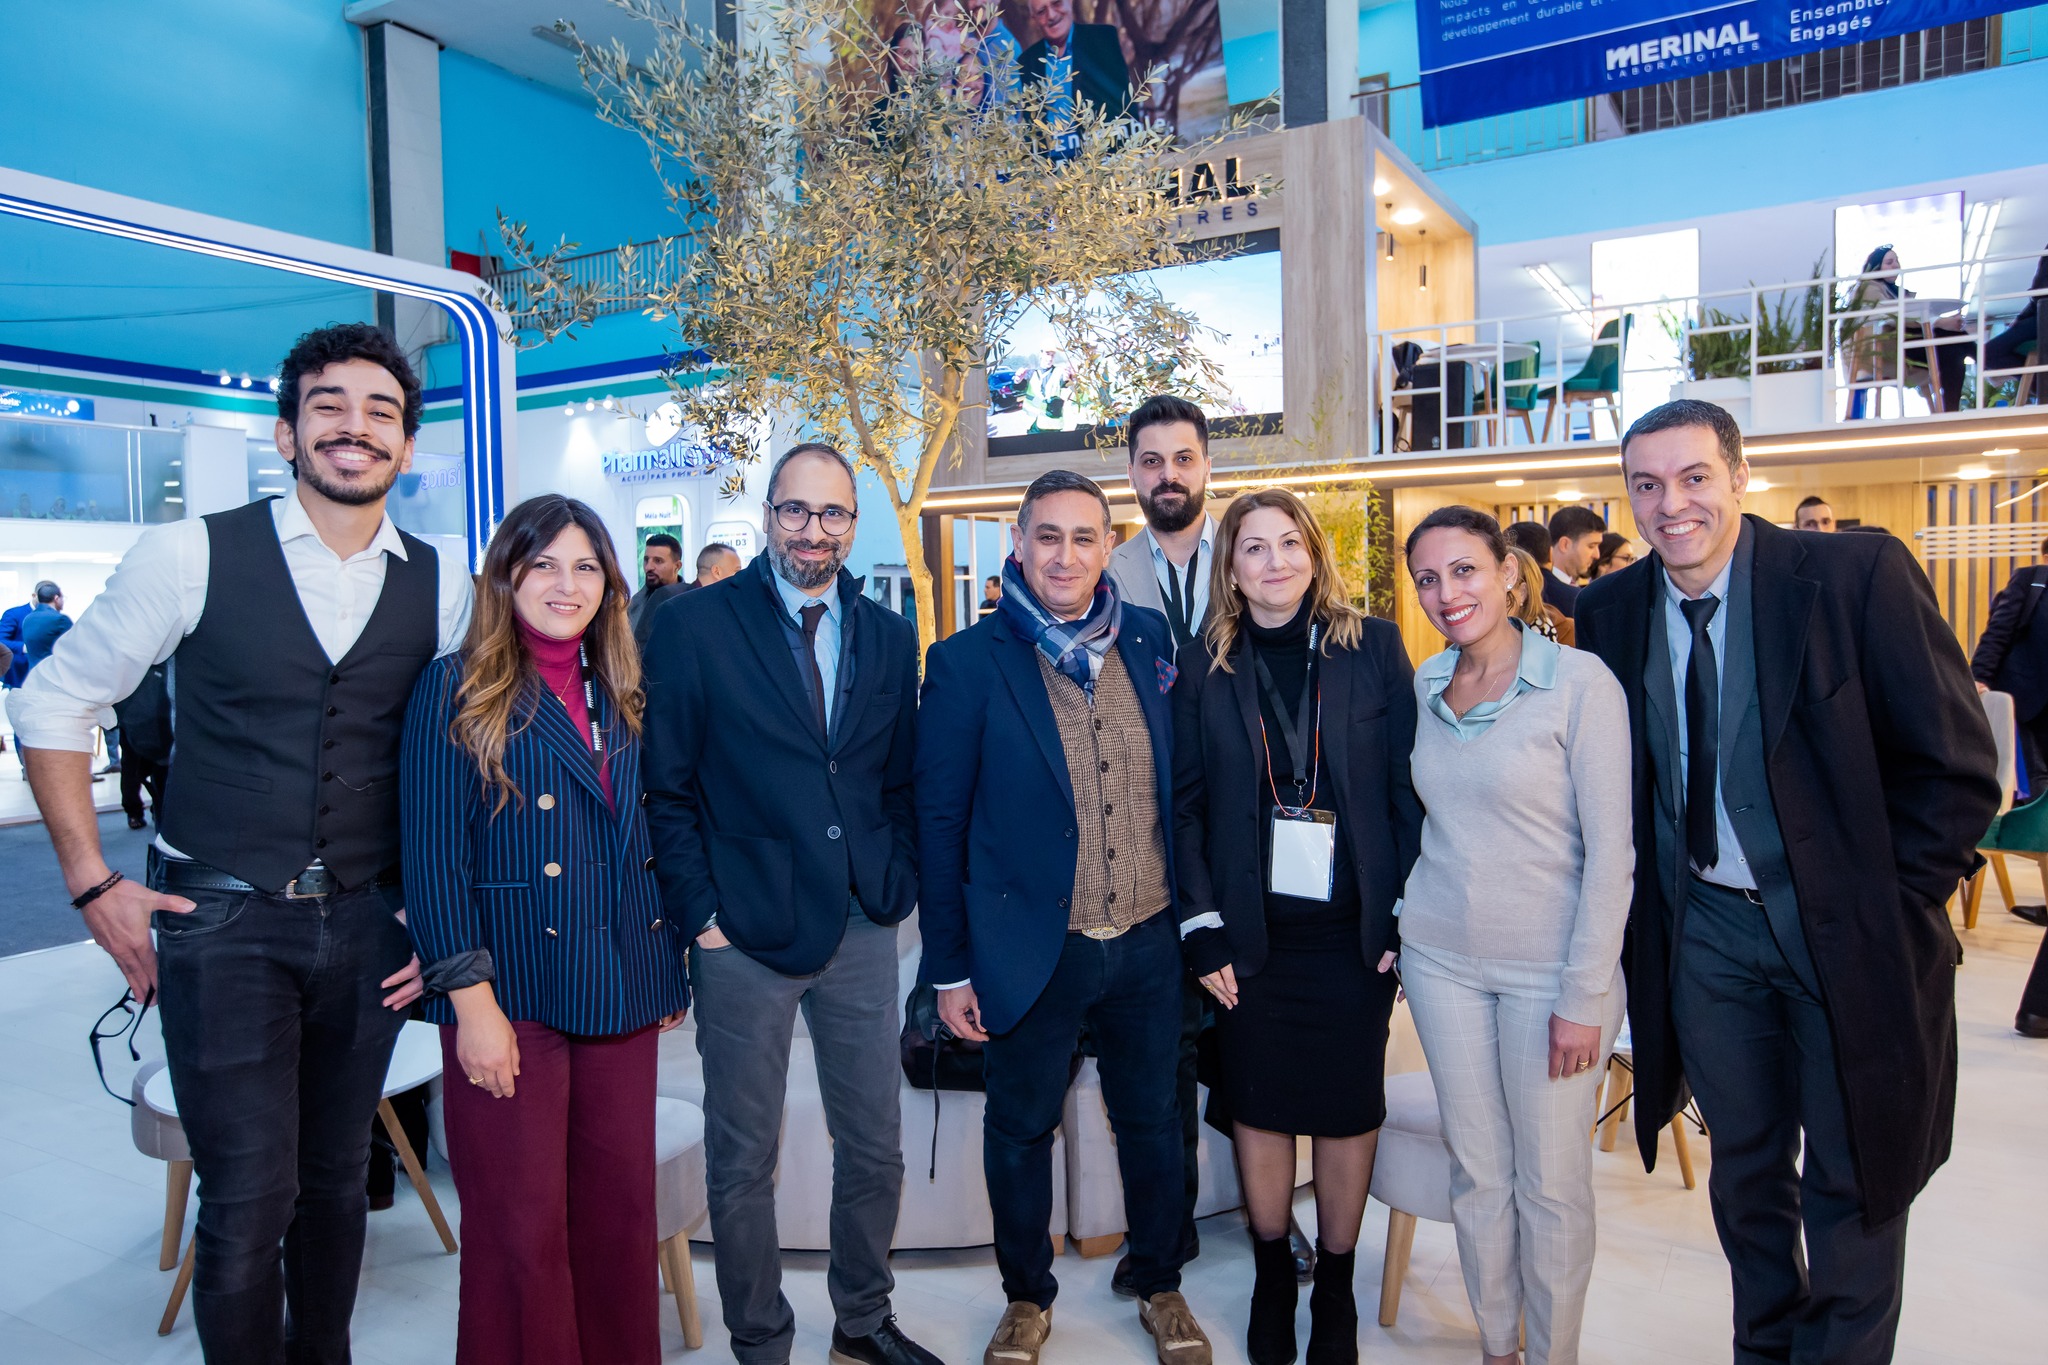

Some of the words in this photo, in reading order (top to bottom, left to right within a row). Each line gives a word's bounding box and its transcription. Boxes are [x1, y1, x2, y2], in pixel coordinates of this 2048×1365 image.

[1440, 6, 1491, 25] impacts
[1502, 2, 1517, 11] en
[1441, 12, 1529, 42] développement
[1536, 0, 1583, 19] durable
[1790, 15, 1872, 43] Engagés
[1606, 20, 1759, 70] MERINAL
[1607, 42, 1760, 80] LABORATOIRES
[650, 473, 667, 481] PAR
